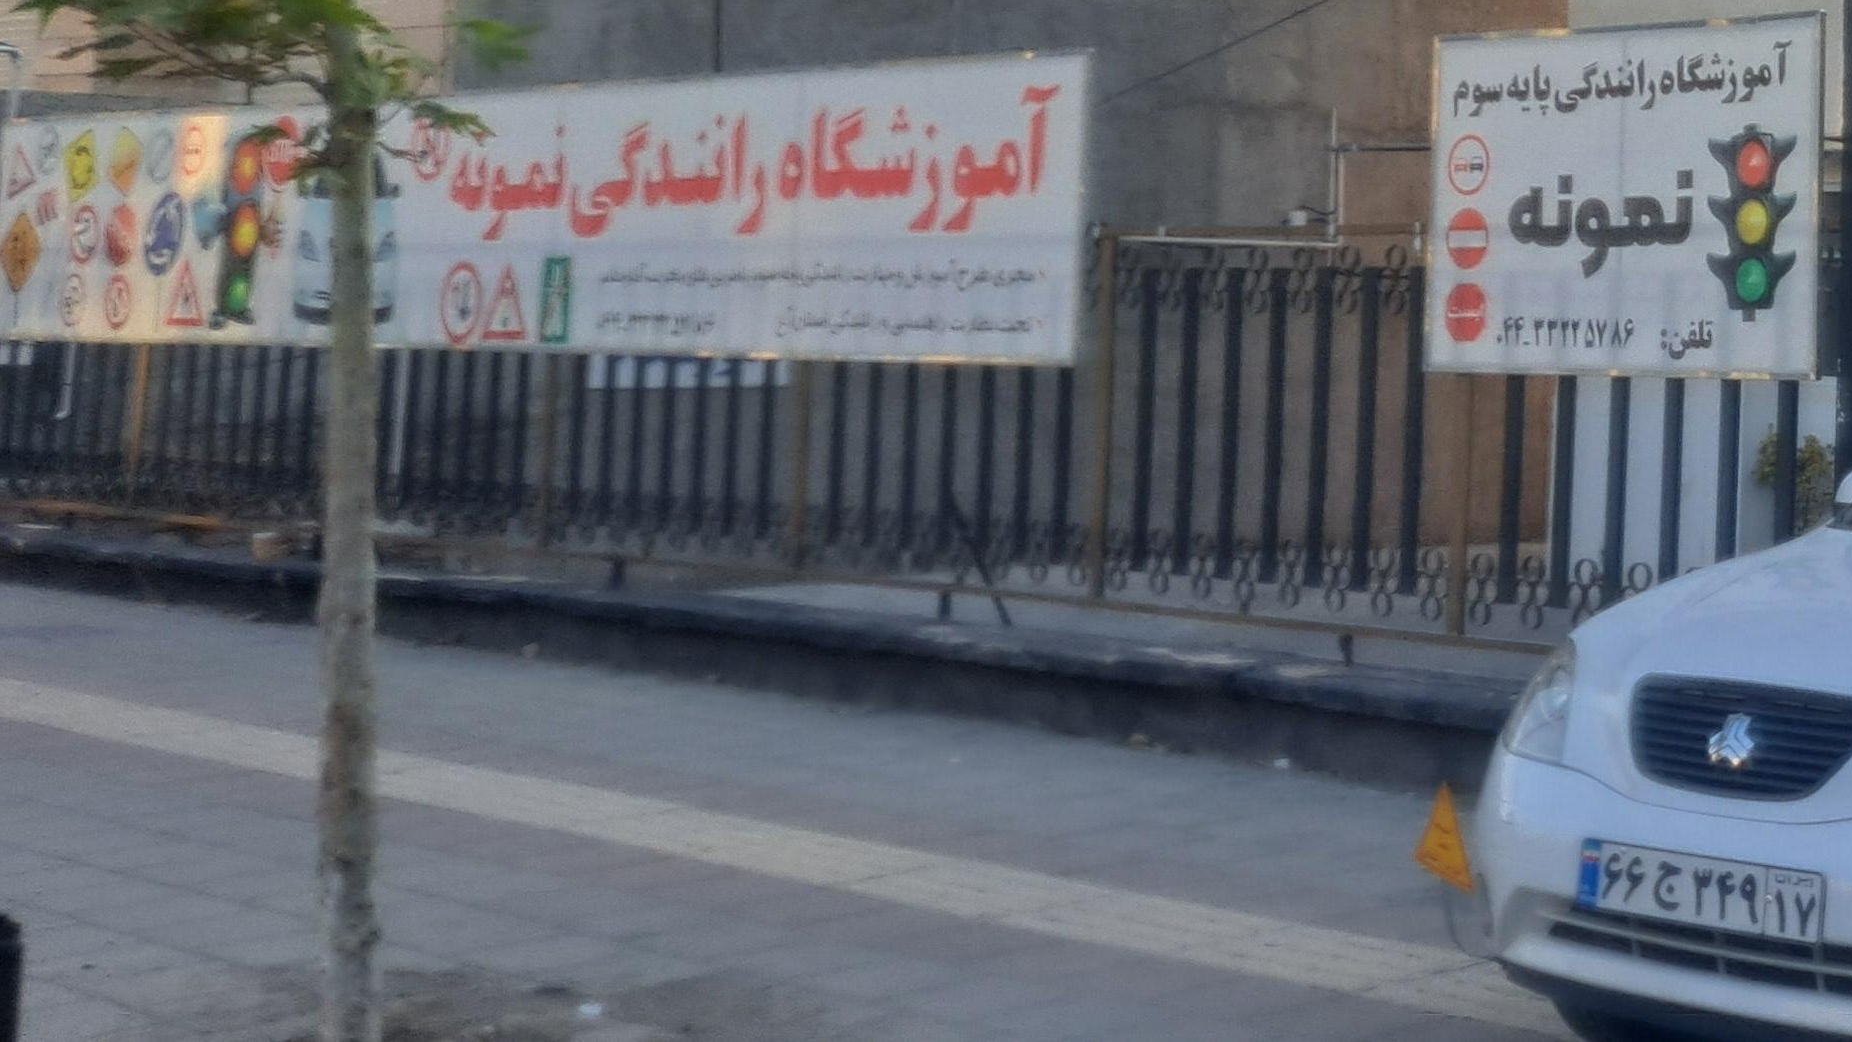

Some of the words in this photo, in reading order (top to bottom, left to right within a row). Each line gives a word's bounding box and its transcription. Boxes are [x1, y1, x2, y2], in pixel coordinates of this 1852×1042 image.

[1453, 78, 1502, 118] سوم
[1505, 64, 1551, 116] پایه
[1554, 57, 1656, 114] رانندگی
[1660, 39, 1792, 104] آموزشگاه
[449, 125, 567, 241] نمونه
[569, 114, 769, 238] رانندگی
[777, 84, 1062, 233] آموزشگاه
[1507, 169, 1694, 279] نمونه
[1775, 888, 1816, 937] ۱۷
